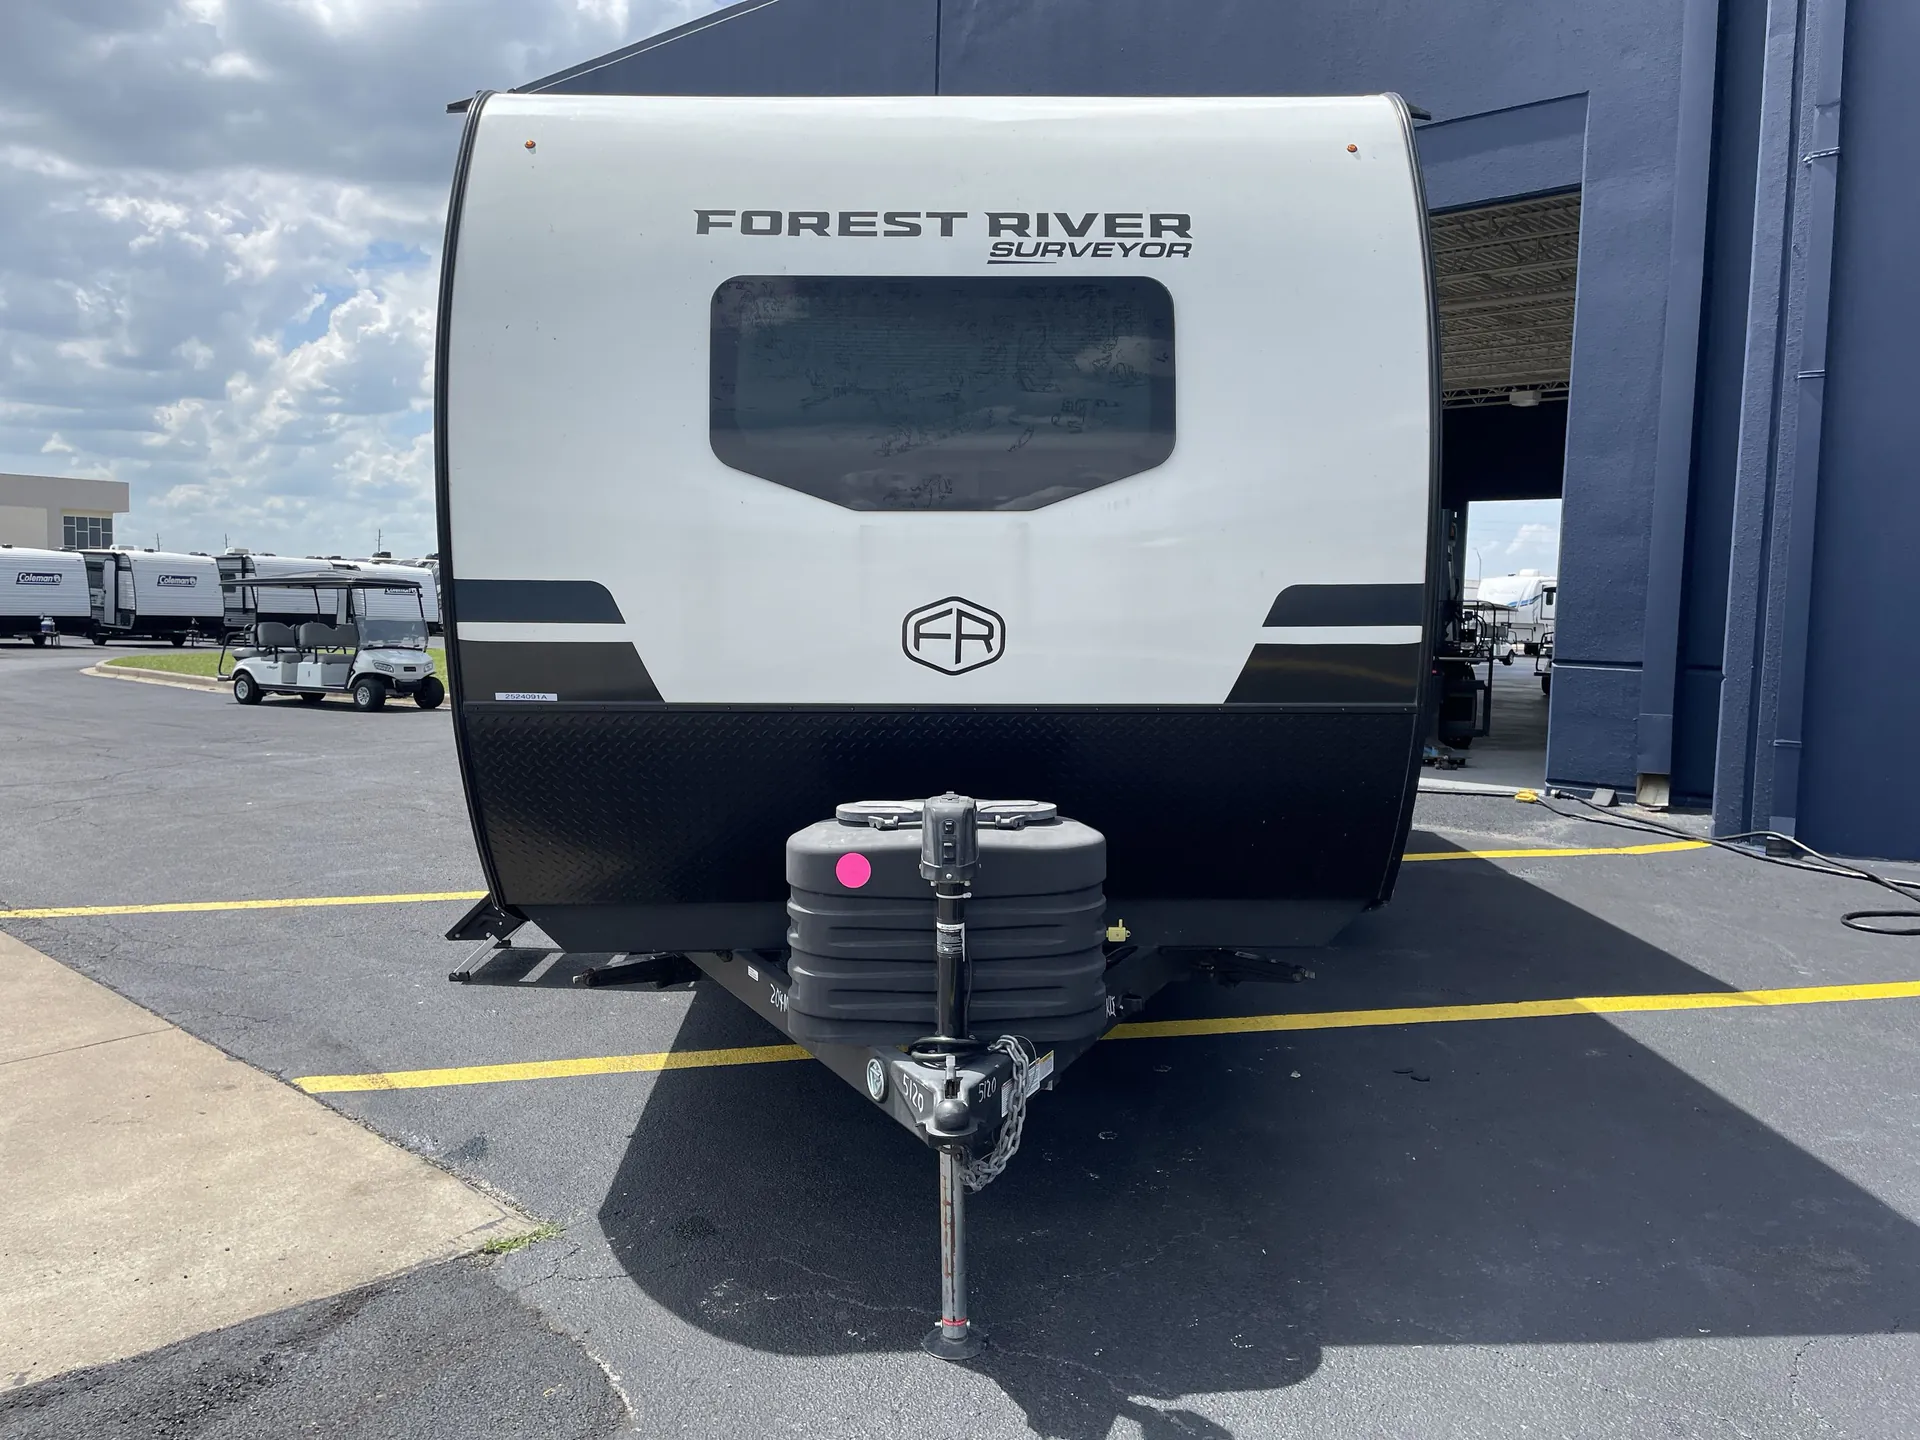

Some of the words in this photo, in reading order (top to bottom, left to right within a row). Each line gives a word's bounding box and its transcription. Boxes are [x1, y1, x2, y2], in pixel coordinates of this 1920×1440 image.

[694, 209, 968, 237] FOREST
[984, 211, 1194, 239] RIVER
[989, 241, 1193, 259] SURVEYOR
[19, 572, 54, 582] Coleman
[160, 575, 190, 584] Coleman
[902, 1073, 924, 1113] 5120
[978, 1077, 997, 1103] 5120
